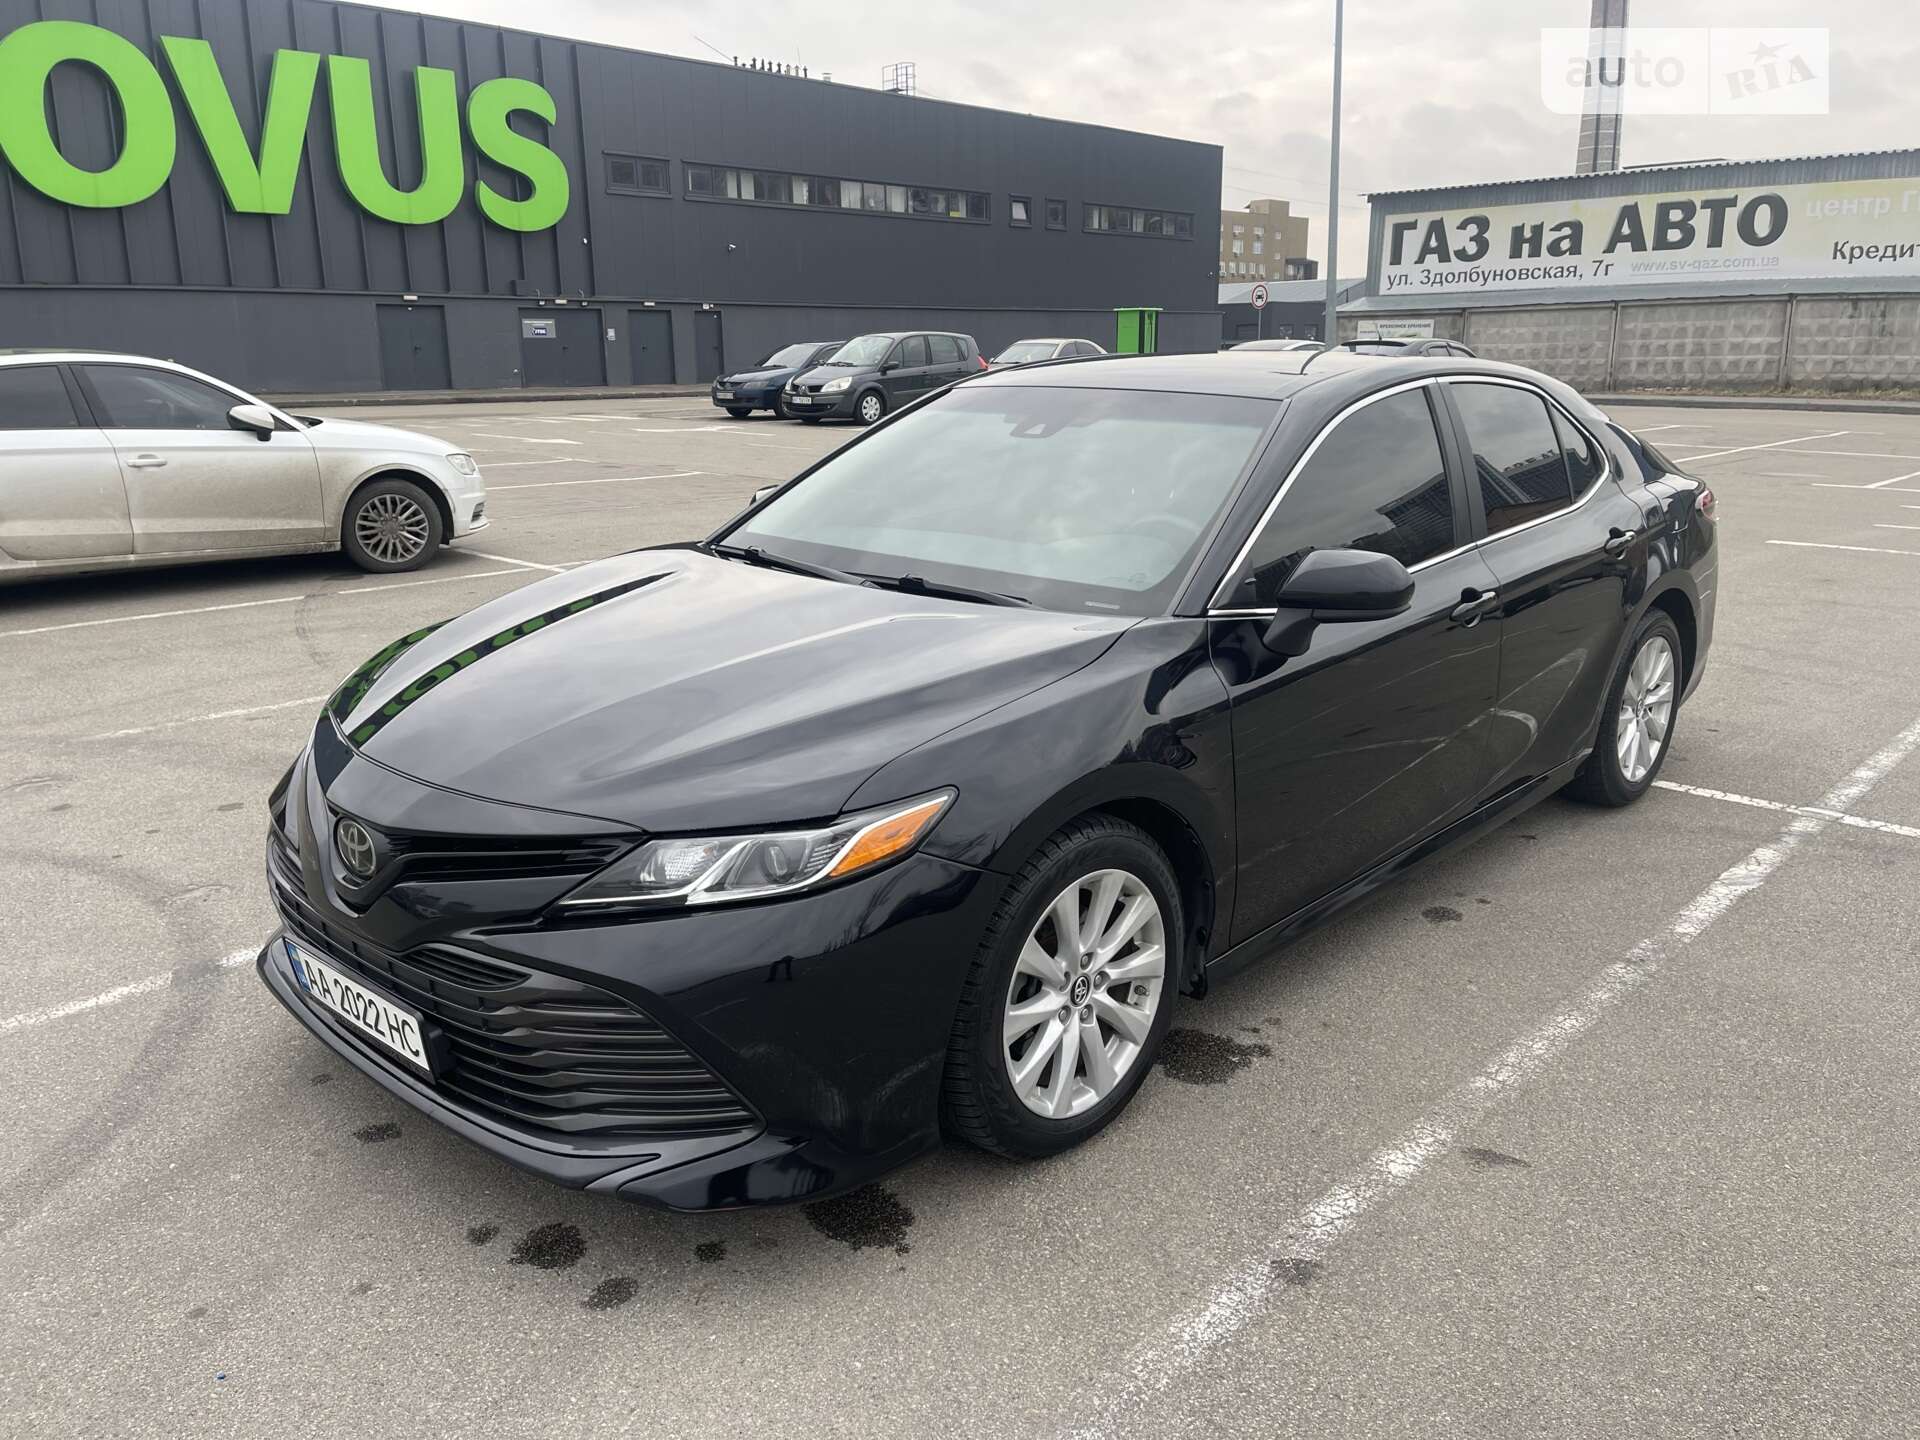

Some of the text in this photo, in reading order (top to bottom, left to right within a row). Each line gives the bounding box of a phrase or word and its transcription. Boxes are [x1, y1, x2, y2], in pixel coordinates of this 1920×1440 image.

[0, 20, 570, 232] OVUS
[1389, 192, 1789, 266] ГАЗ на АВТО
[1806, 197, 1891, 219] центр
[1387, 260, 1615, 290] ул. Здолбуновская, 7г
[304, 959, 420, 1057] AA 2022 HC
